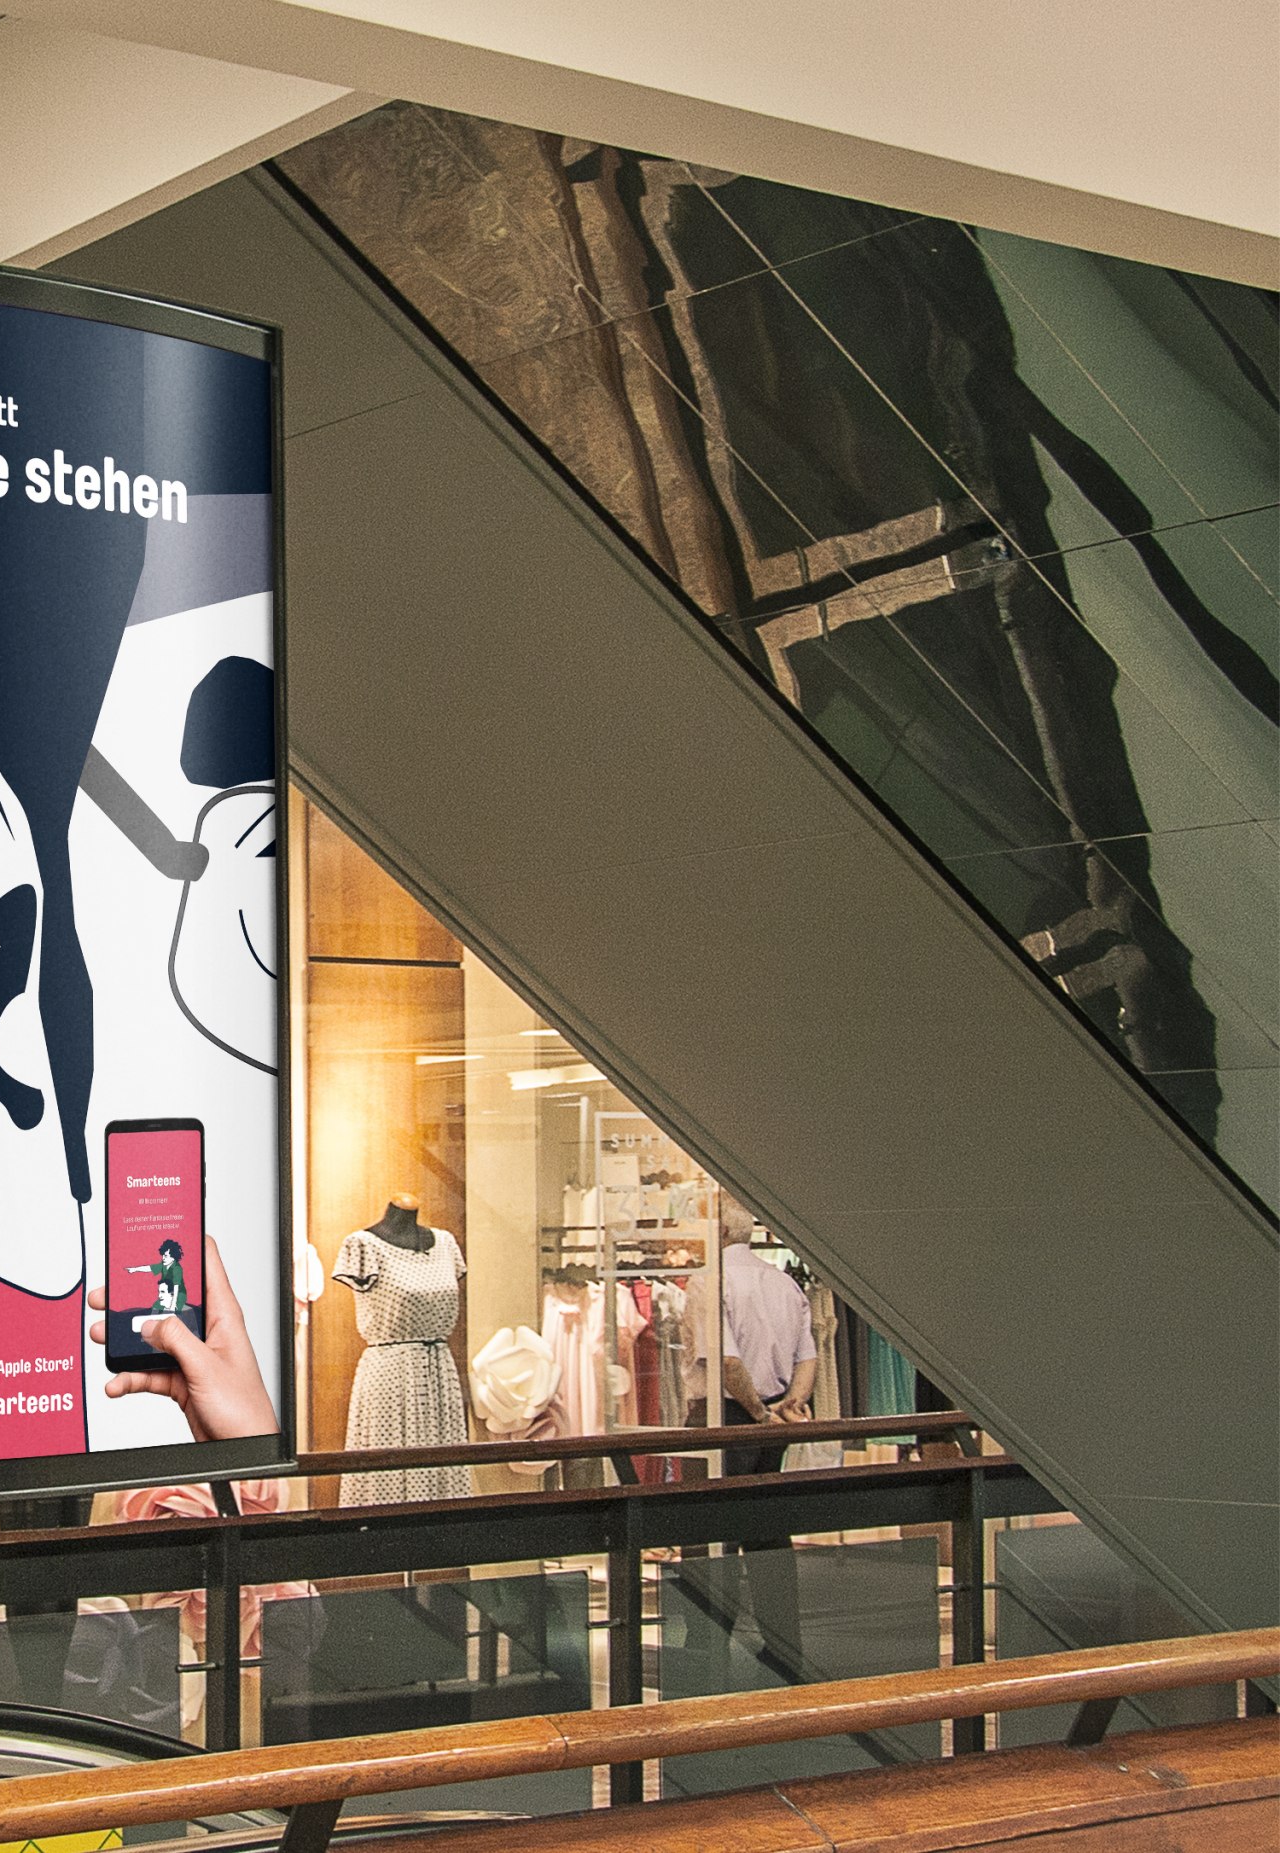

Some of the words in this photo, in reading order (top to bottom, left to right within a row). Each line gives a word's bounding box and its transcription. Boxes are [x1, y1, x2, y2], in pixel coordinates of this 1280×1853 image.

[24, 449, 189, 524] stehen
[126, 1175, 181, 1188] Smarteens
[34, 1355, 74, 1373] Store!
